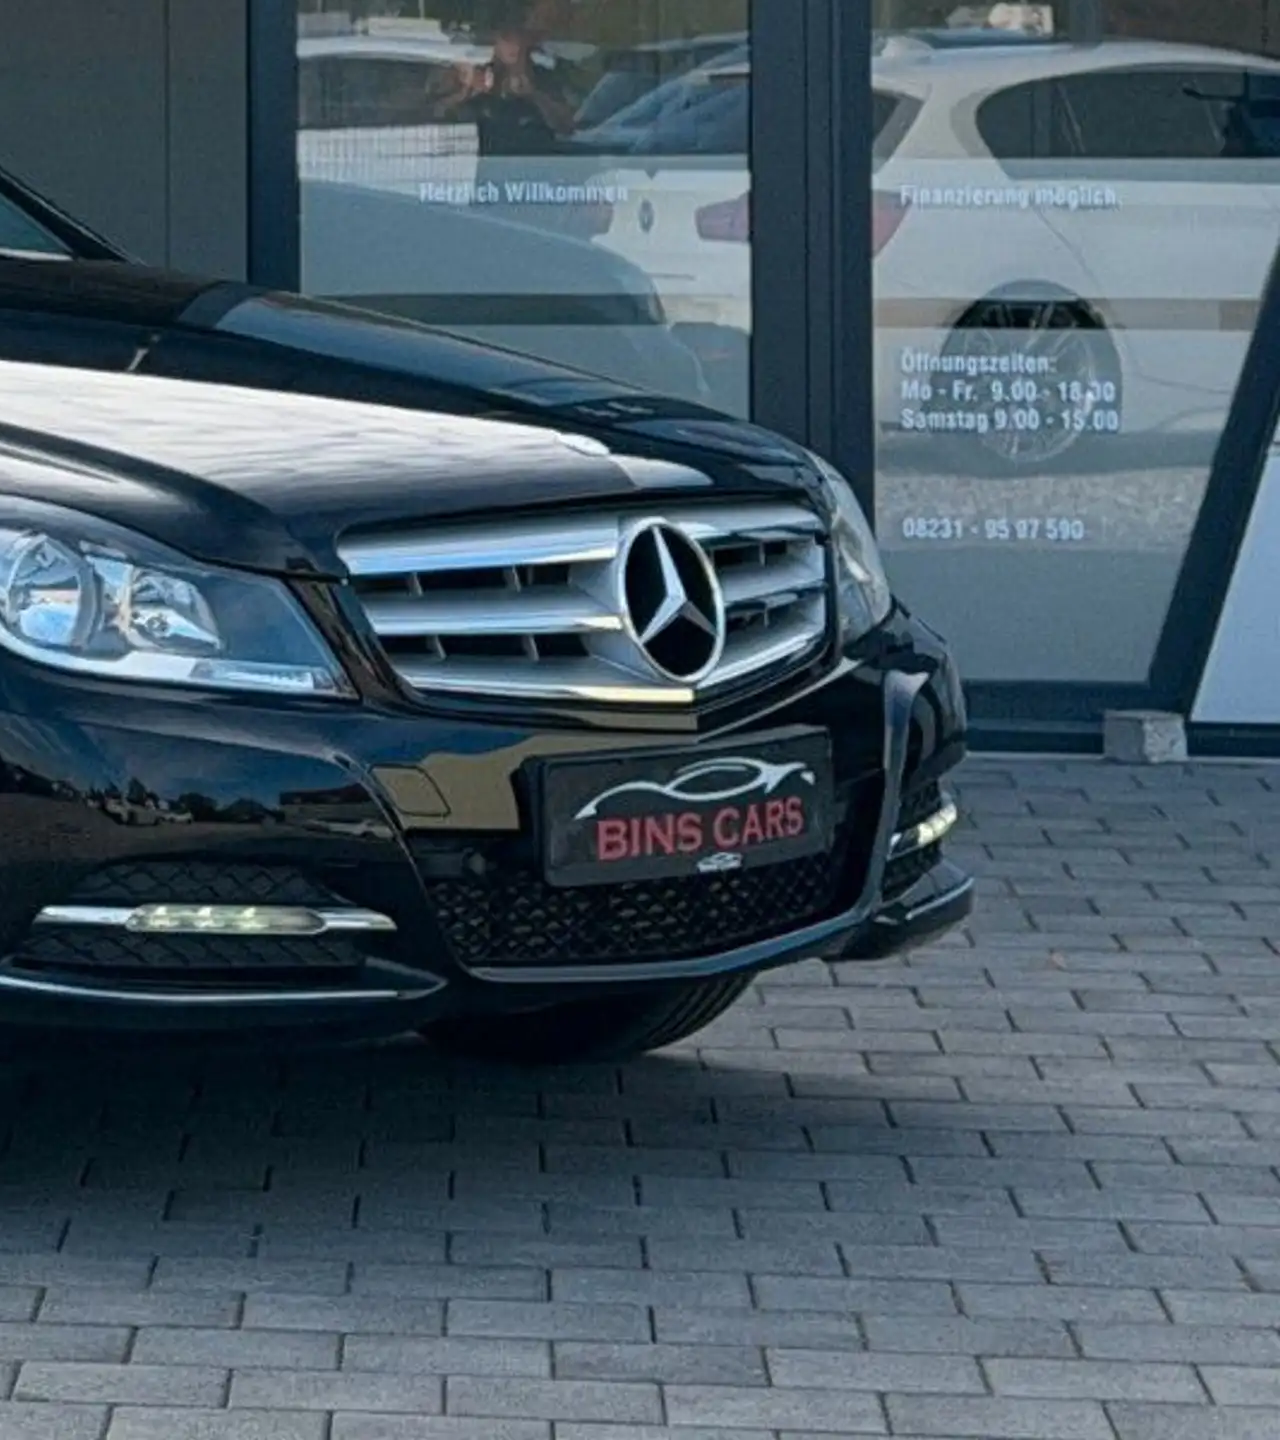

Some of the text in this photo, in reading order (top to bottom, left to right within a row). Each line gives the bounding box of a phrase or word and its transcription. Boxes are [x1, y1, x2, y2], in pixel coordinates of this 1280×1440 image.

[505, 181, 628, 203] Willkommen
[900, 185, 1030, 208] Finanzierung
[901, 381, 931, 400] Mo
[953, 380, 977, 401] Fr.
[991, 380, 1037, 402] 9.00
[901, 409, 989, 433] Samstag
[994, 410, 1040, 430] 9.00
[903, 517, 962, 539] 08231
[597, 796, 804, 860] BINS CARS
